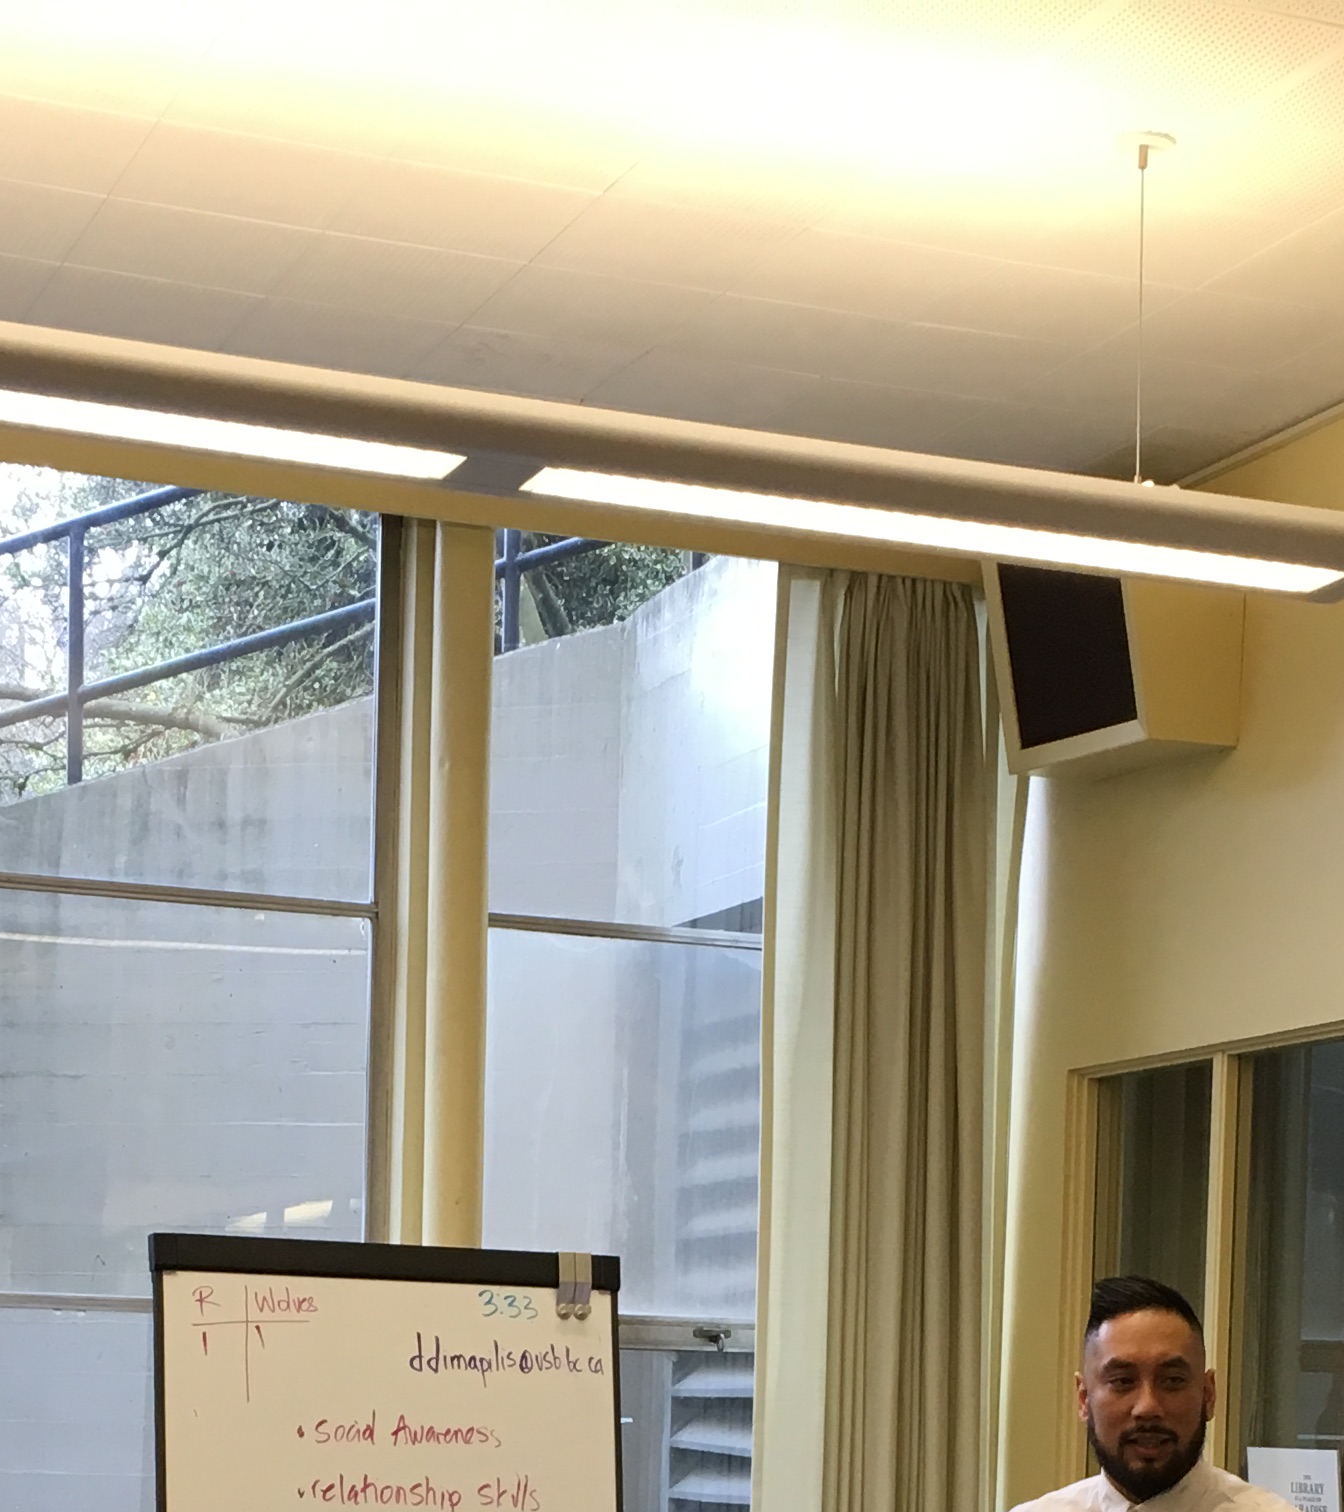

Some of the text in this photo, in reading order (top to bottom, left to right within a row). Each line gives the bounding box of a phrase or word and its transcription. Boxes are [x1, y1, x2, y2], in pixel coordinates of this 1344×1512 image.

[192, 1285, 221, 1317] R
[390, 1414, 502, 1449] Awareness
[1290, 1481, 1324, 1496] LIBRARY
